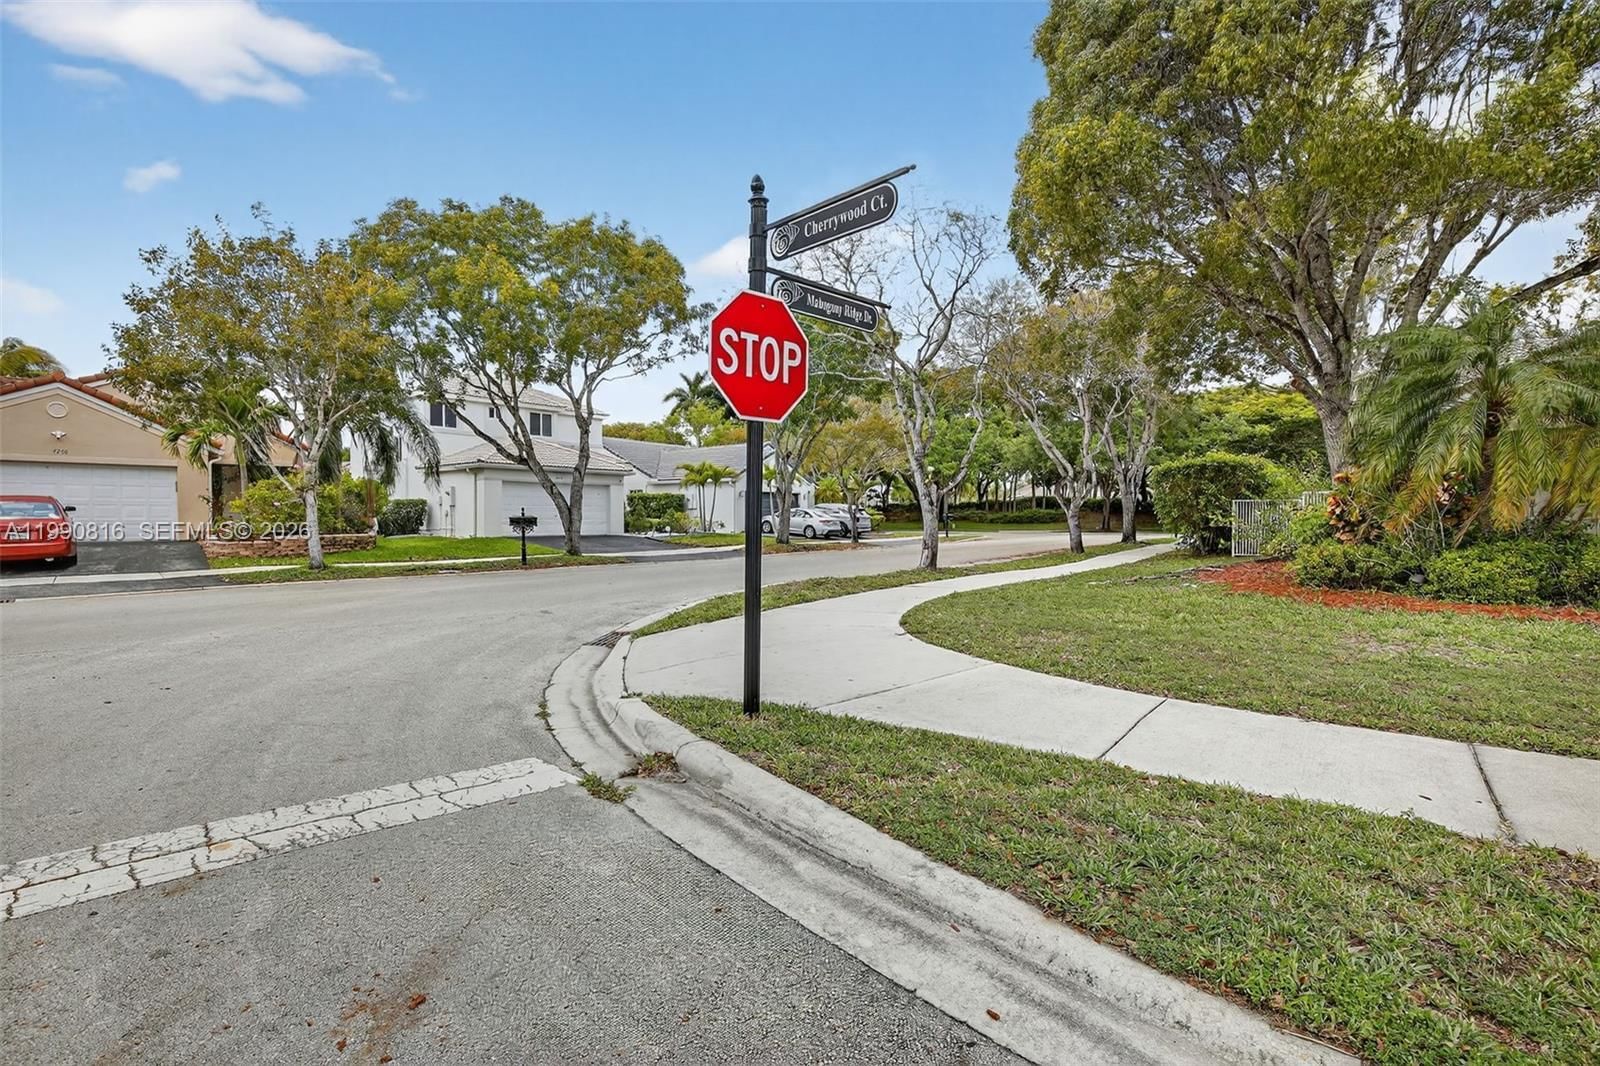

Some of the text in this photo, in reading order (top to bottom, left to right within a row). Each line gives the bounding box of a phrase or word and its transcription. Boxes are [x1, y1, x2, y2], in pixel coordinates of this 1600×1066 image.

[804, 194, 888, 238] Cherrywood Ct.
[844, 304, 863, 323] Ridge
[717, 327, 802, 385] STOP
